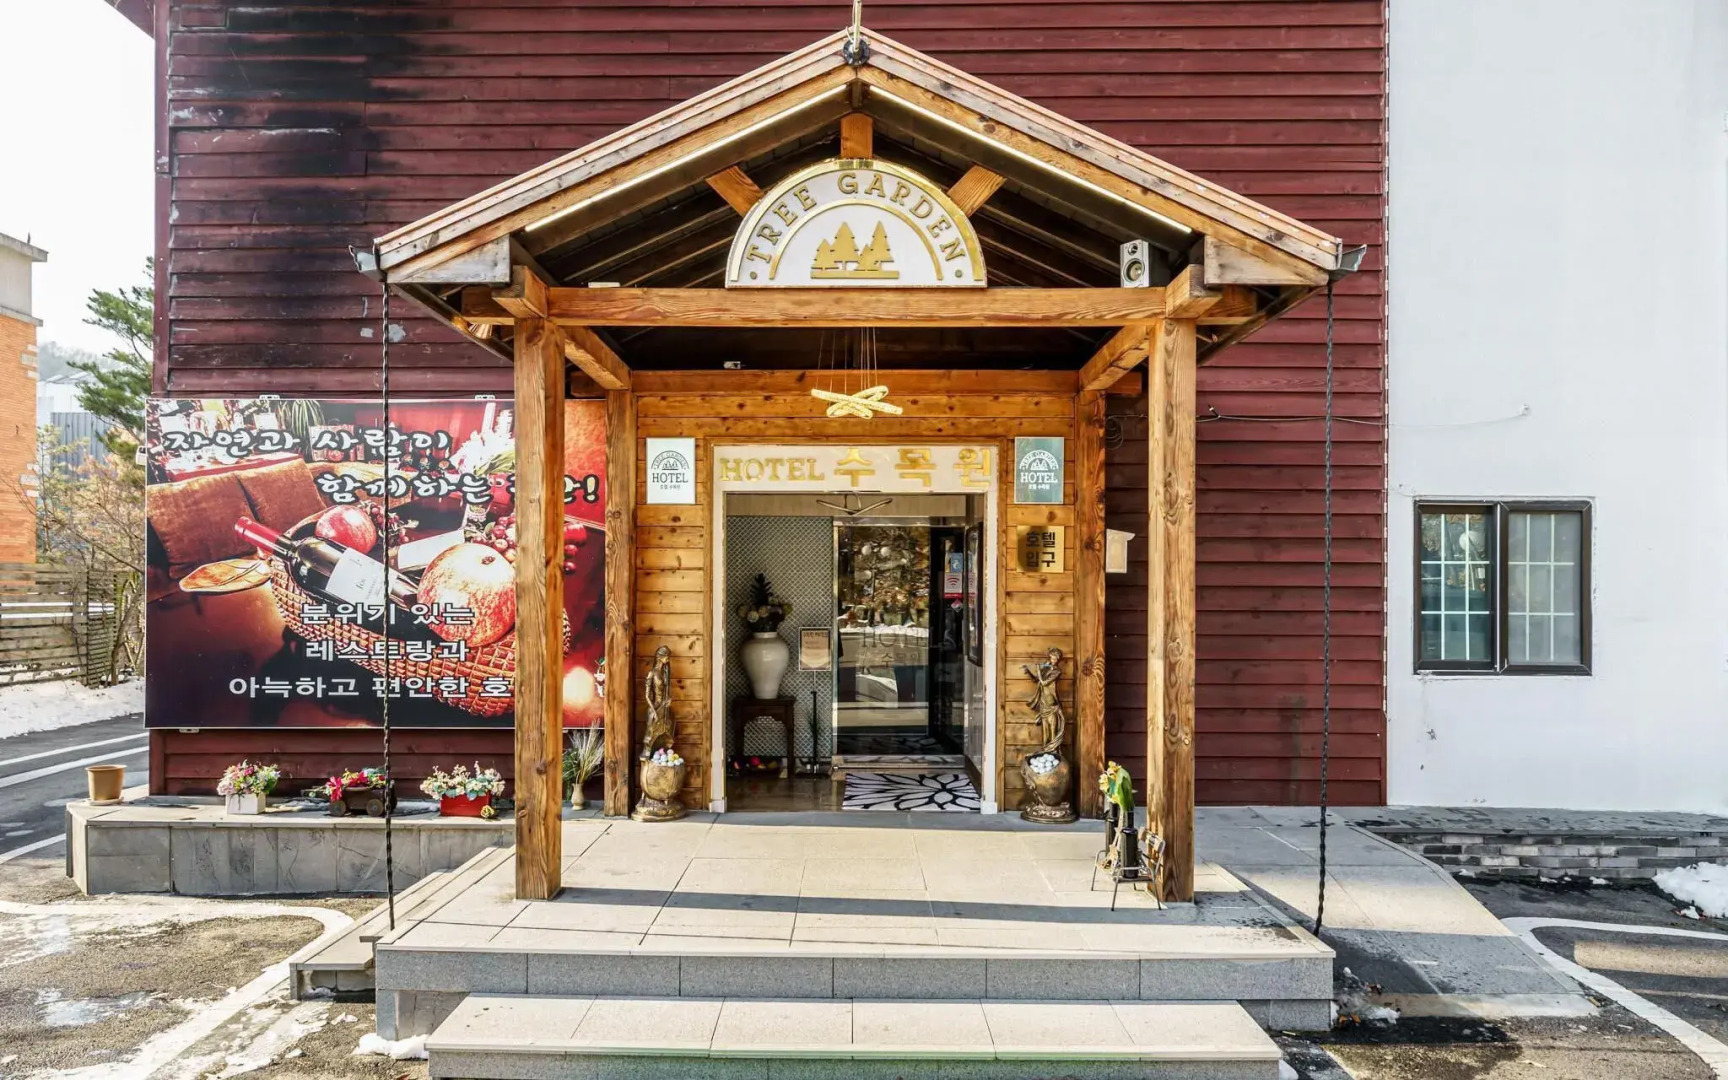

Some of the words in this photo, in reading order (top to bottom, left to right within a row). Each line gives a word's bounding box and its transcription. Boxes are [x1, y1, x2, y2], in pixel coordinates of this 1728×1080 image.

[746, 184, 818, 264] TREE
[836, 172, 967, 263] GARDEN
[163, 429, 302, 458] 자연과
[313, 428, 453, 457] 사람이
[652, 472, 688, 483] HOTEL
[718, 457, 825, 482] HOTEL
[833, 447, 991, 488] 수목원
[1020, 472, 1058, 483] HOTEL
[1025, 531, 1056, 548] 호텔
[1025, 551, 1056, 568] 입구
[300, 603, 397, 626] 분위기
[410, 603, 476, 626] 있는
[305, 640, 470, 662] 레스트랑과
[228, 676, 360, 699] 아늑하고
[371, 676, 470, 699] 편안한
[479, 676, 513, 698] 호
